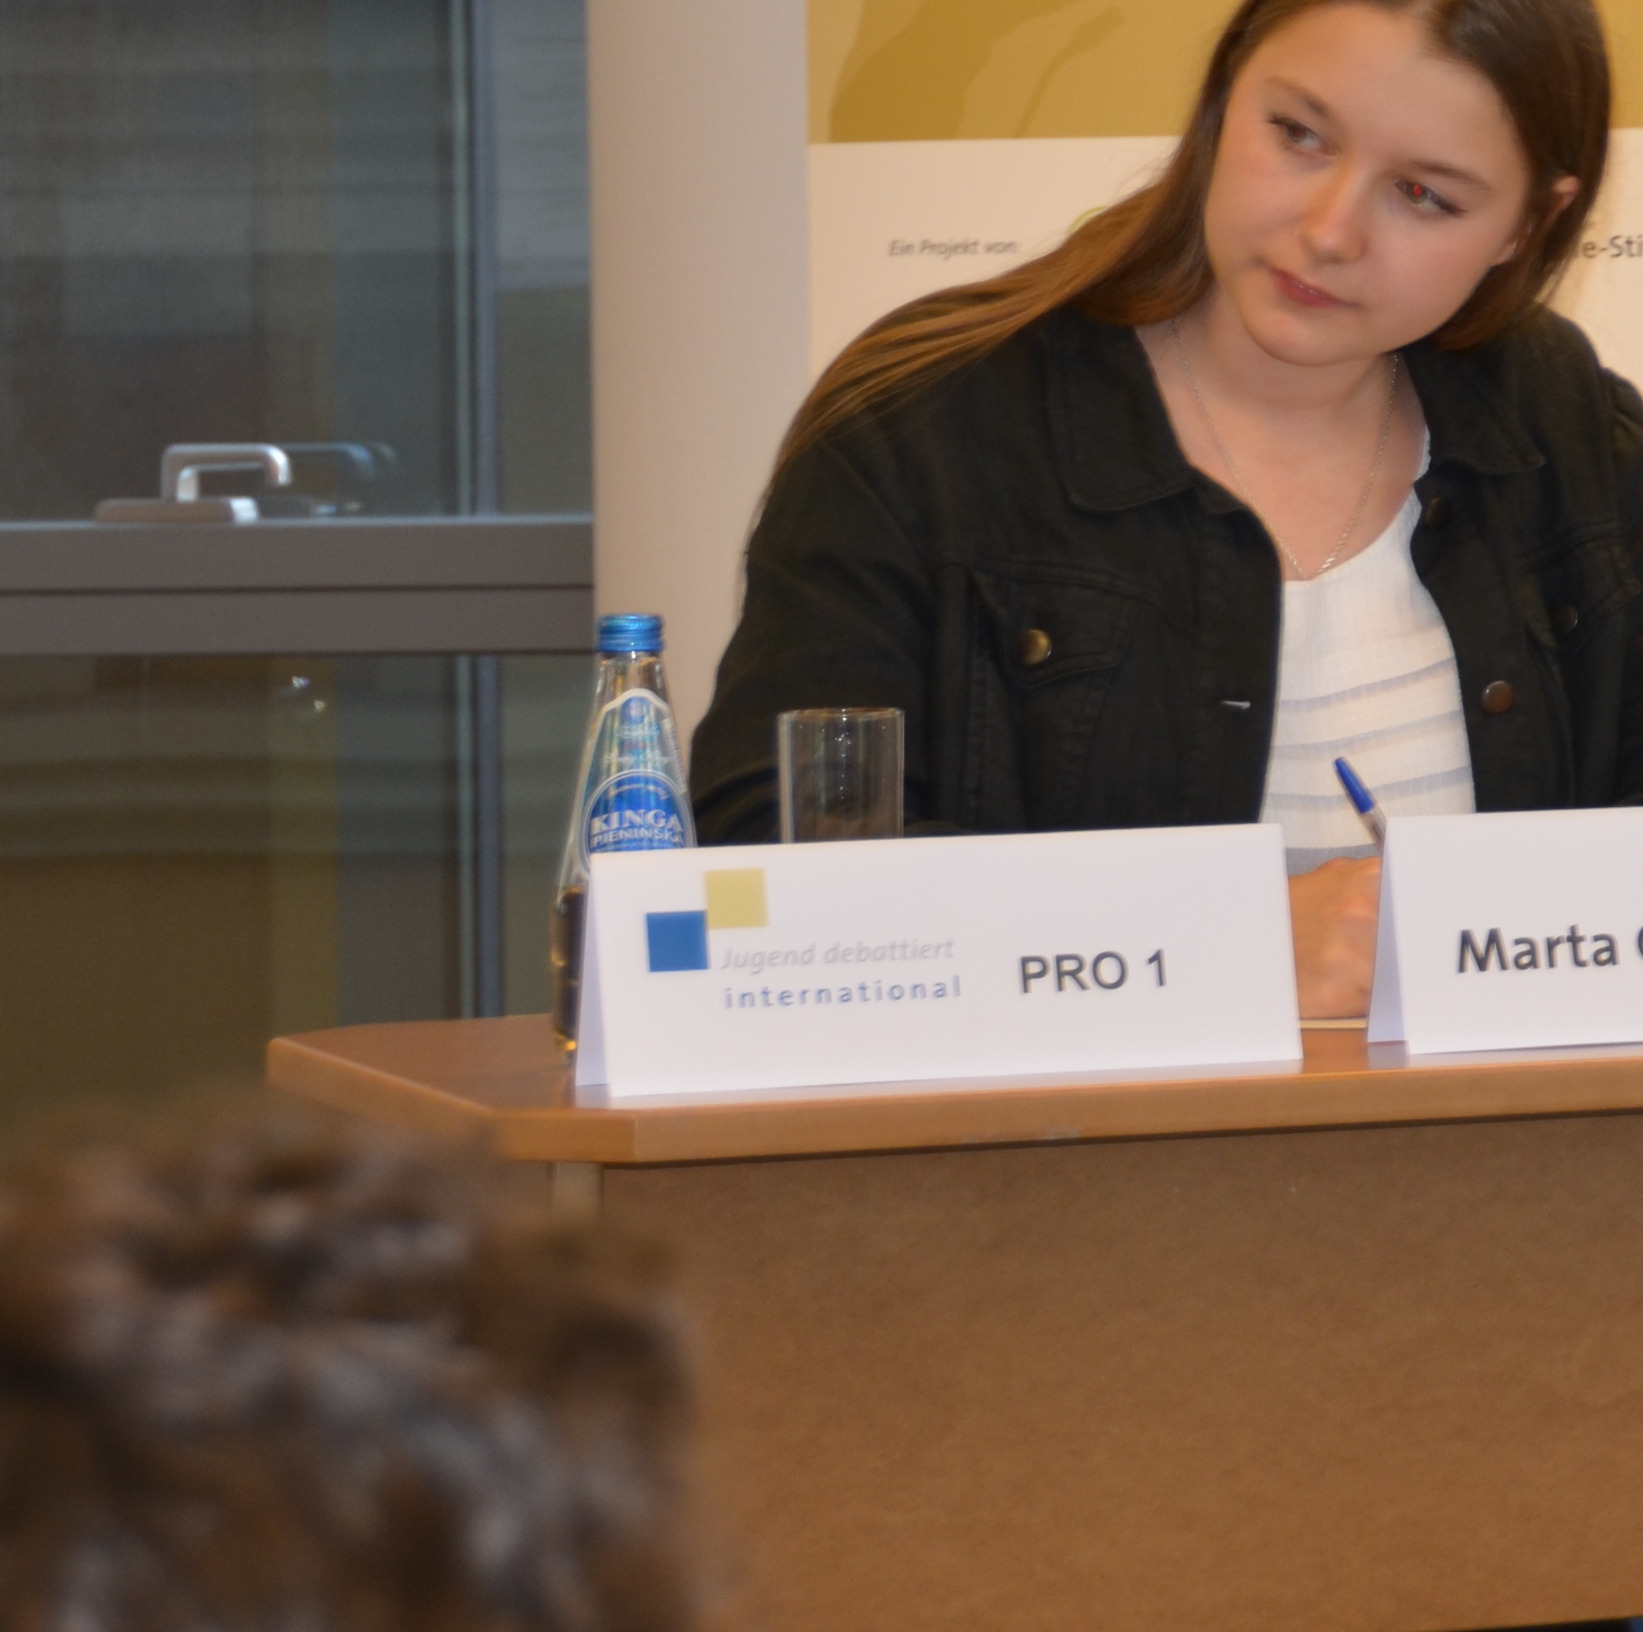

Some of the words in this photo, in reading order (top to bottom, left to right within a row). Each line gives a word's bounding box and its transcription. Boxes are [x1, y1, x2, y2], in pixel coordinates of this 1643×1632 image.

[888, 240, 914, 257] Ein
[919, 238, 979, 261] Projekt
[590, 808, 684, 835] KINGA
[722, 944, 816, 974] Jugend
[823, 937, 955, 965] debattiert
[1456, 926, 1618, 974] Marta
[1019, 950, 1128, 994] PRO
[1145, 948, 1168, 987] 1
[723, 975, 961, 1010] international
